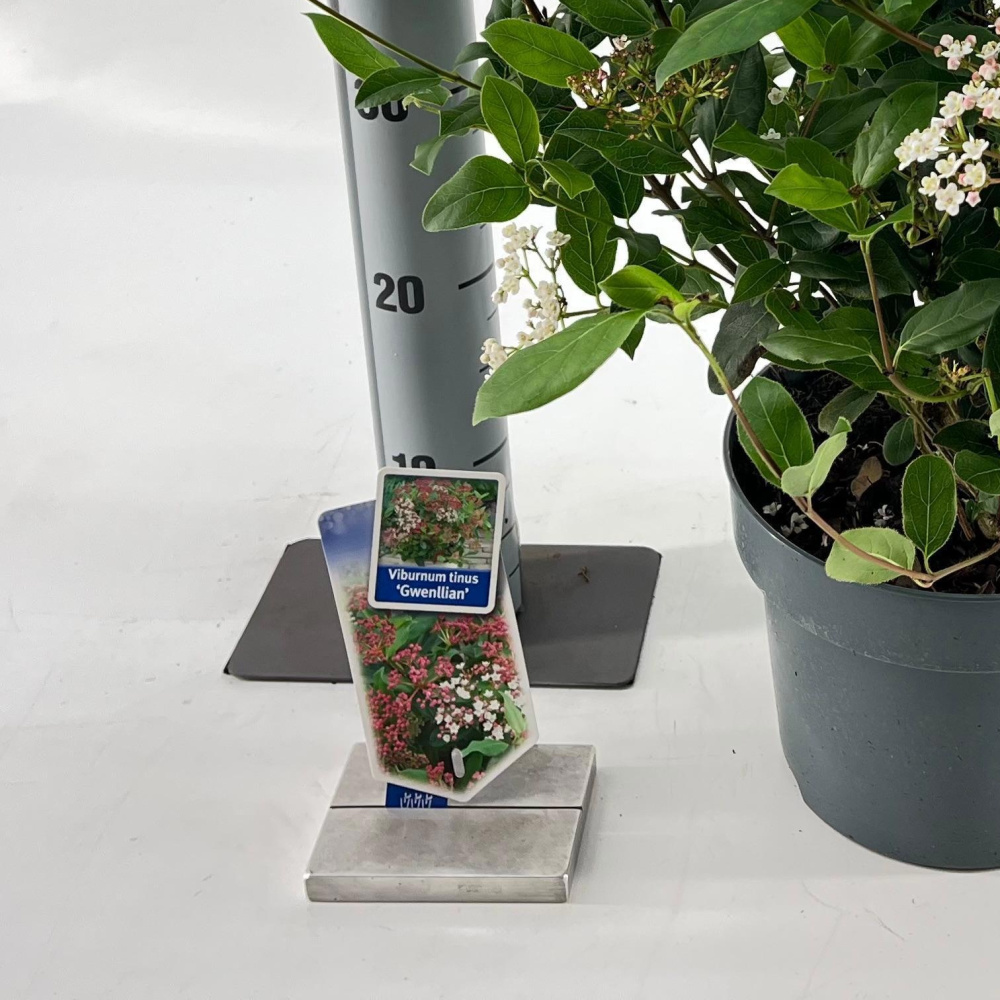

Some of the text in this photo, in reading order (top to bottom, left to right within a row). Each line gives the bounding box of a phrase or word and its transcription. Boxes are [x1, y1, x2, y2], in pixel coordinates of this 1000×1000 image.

[373, 272, 425, 314] 20
[388, 568, 479, 584] Viburnum tinus
